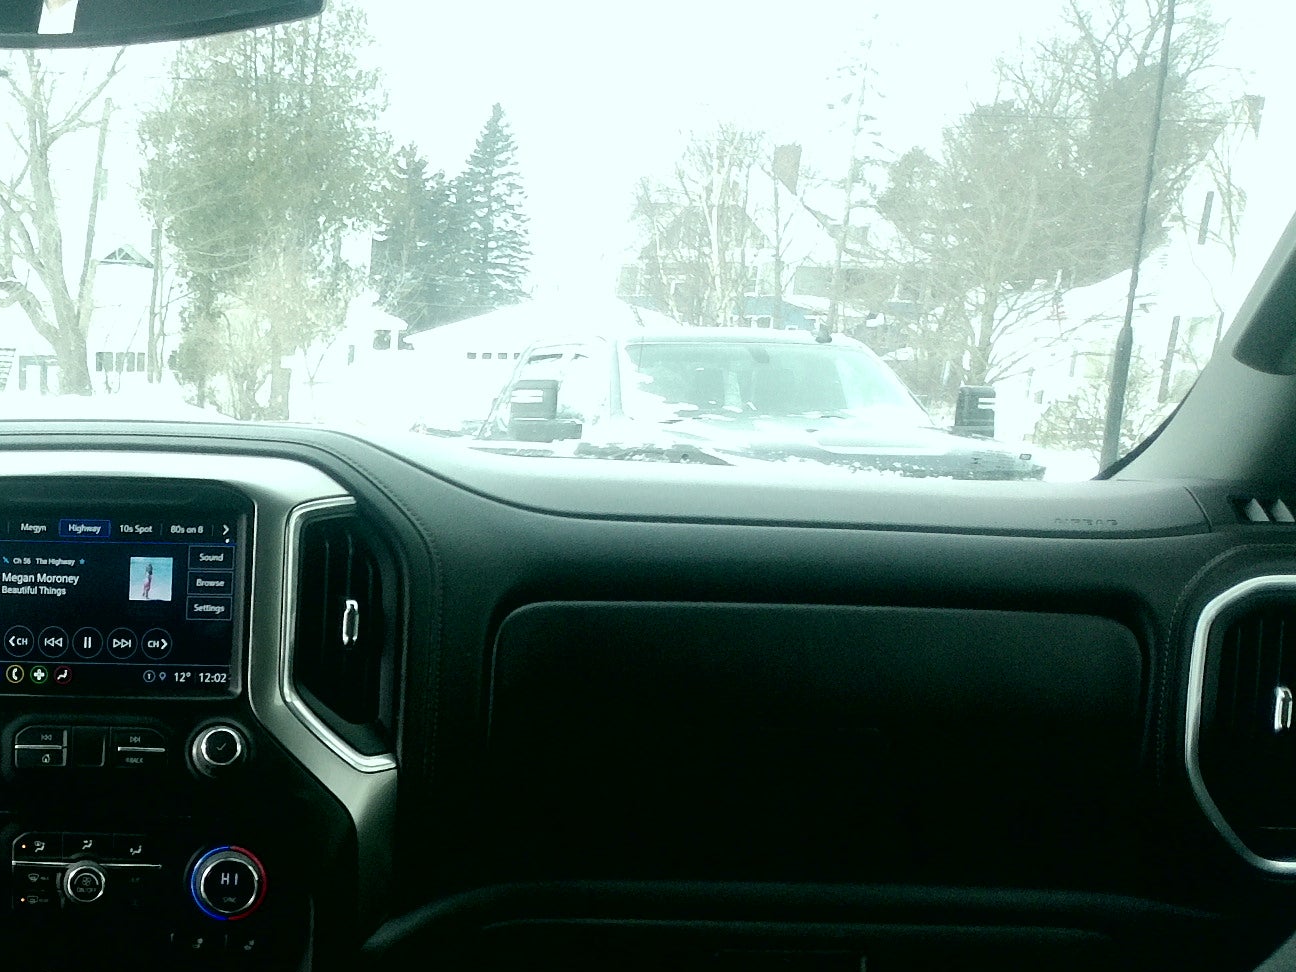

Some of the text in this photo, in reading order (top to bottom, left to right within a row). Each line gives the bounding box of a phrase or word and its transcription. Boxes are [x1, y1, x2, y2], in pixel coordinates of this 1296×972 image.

[20, 522, 47, 534] Megyn
[68, 523, 102, 535] Highway
[119, 524, 153, 535] 10s Spot
[170, 525, 185, 534] 80s
[186, 526, 197, 534] on
[48, 558, 76, 567] Highway
[199, 552, 224, 562] Sound
[1, 572, 80, 586] Megan Moroney
[196, 578, 225, 587] Browse
[1, 585, 67, 597] Beautiful Things
[193, 603, 225, 615] Settings
[16, 637, 28, 646] CH
[147, 640, 160, 649] CH
[198, 672, 227, 683] 12:02
[220, 872, 239, 886] HI
